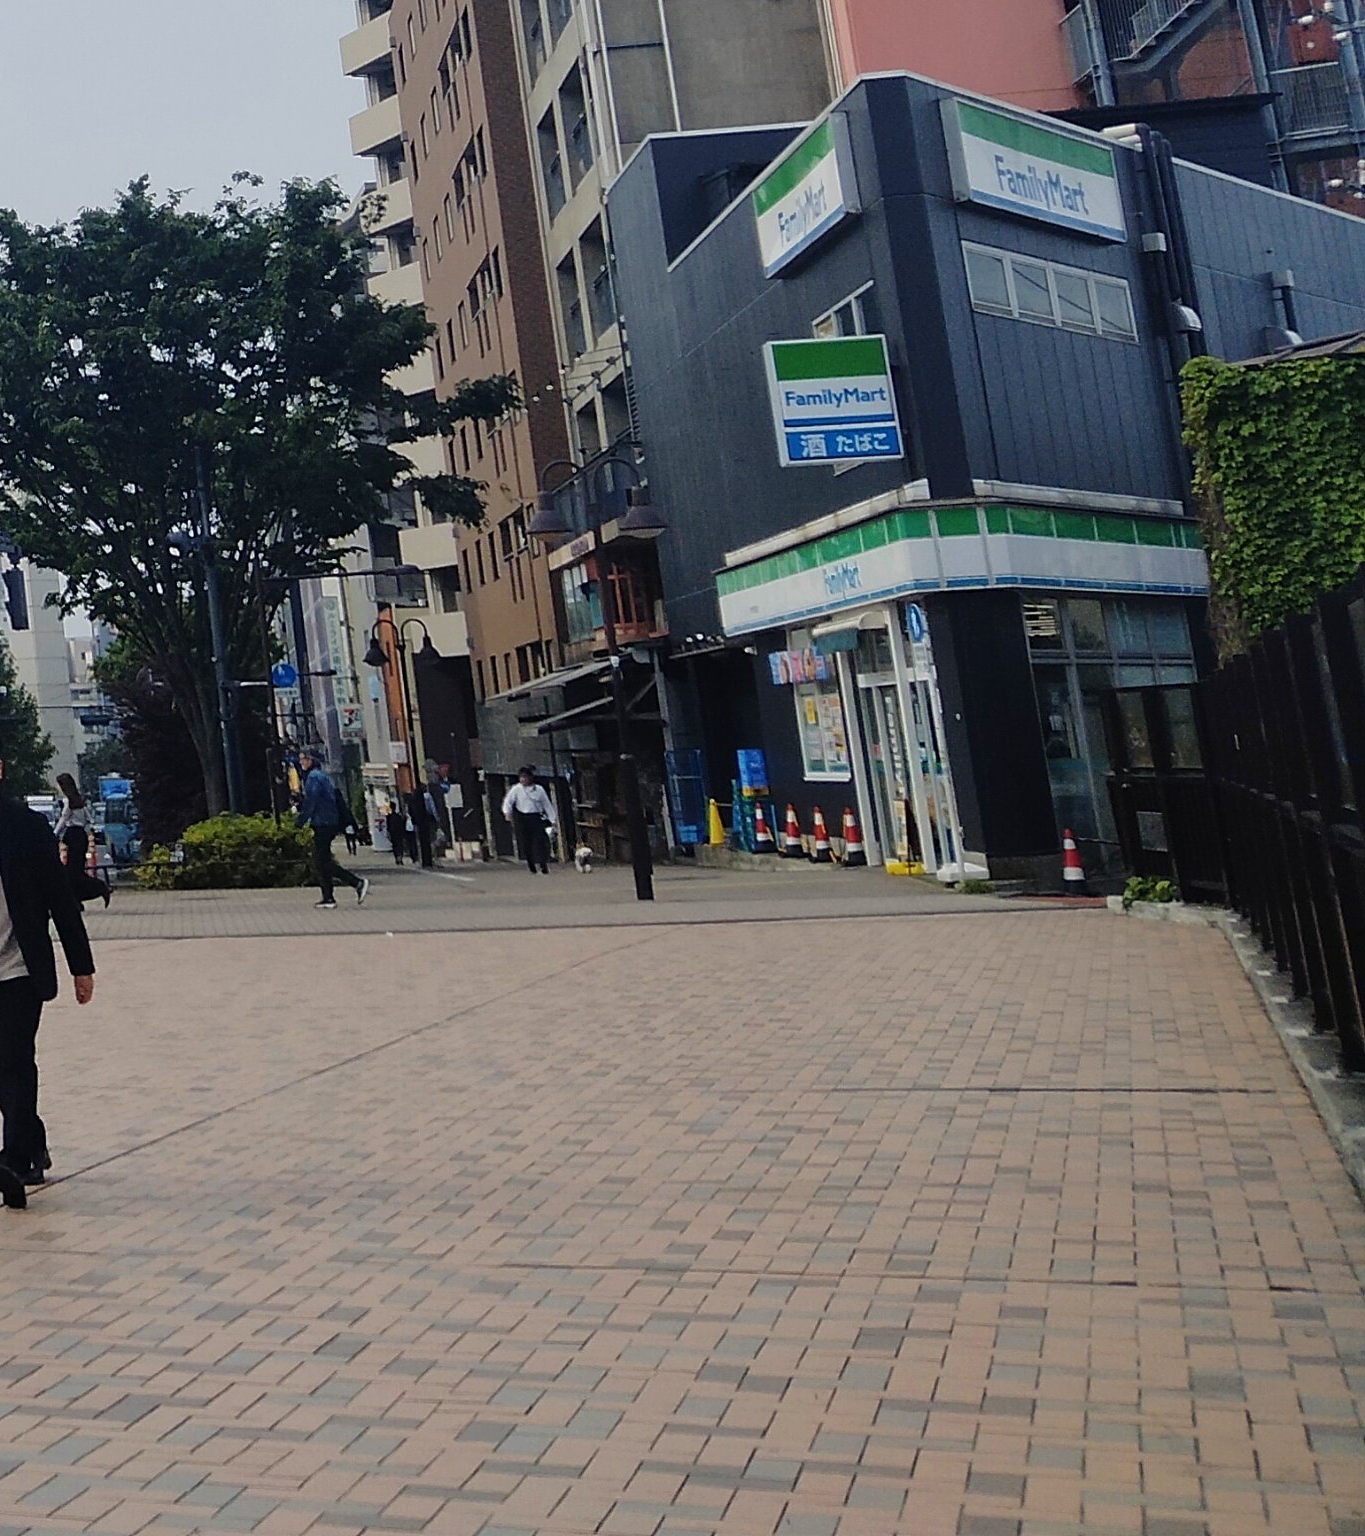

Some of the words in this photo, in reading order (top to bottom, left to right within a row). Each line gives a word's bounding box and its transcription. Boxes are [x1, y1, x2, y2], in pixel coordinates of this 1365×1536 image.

[993, 154, 1090, 216] FamilyMart
[776, 180, 827, 250] FamilyMart
[784, 387, 887, 409] FamilyMart
[800, 433, 828, 458] 酒
[836, 432, 891, 453] たばこ
